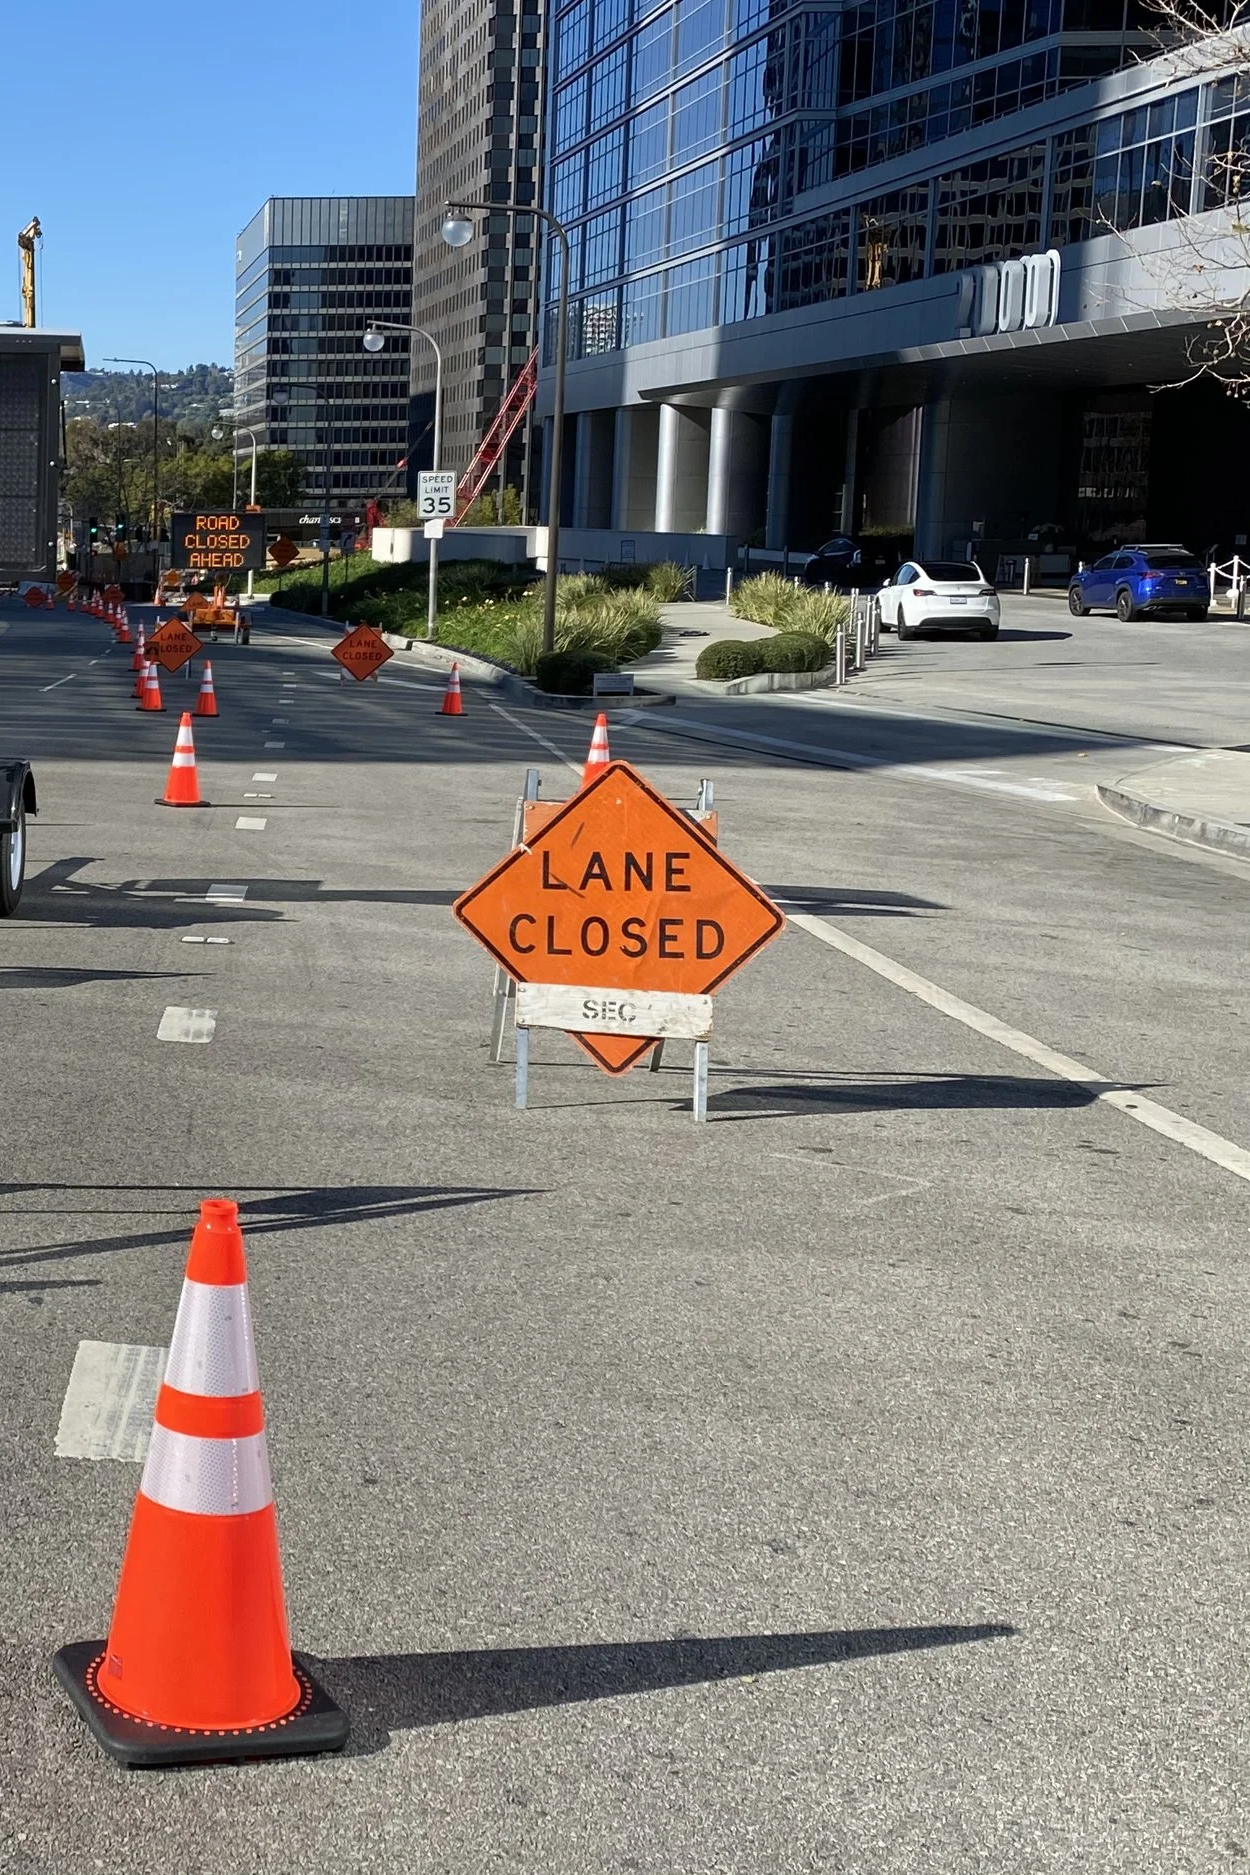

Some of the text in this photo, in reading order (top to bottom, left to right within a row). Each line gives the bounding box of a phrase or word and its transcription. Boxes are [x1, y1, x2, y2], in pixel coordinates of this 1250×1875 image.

[422, 475, 453, 483] SPEED
[424, 486, 449, 494] LIMIT
[422, 497, 451, 513] 35
[196, 516, 240, 530] ROAD
[299, 514, 321, 524] char
[184, 534, 251, 549] CLOSED
[189, 553, 245, 567] AHEAD
[160, 632, 188, 641] LANE
[160, 644, 192, 654] LOSED
[349, 639, 378, 649] LANE
[342, 651, 383, 661] CLOSED
[542, 850, 692, 892] LANE
[509, 913, 725, 960] CLOSED
[582, 1000, 637, 1023] SEC
